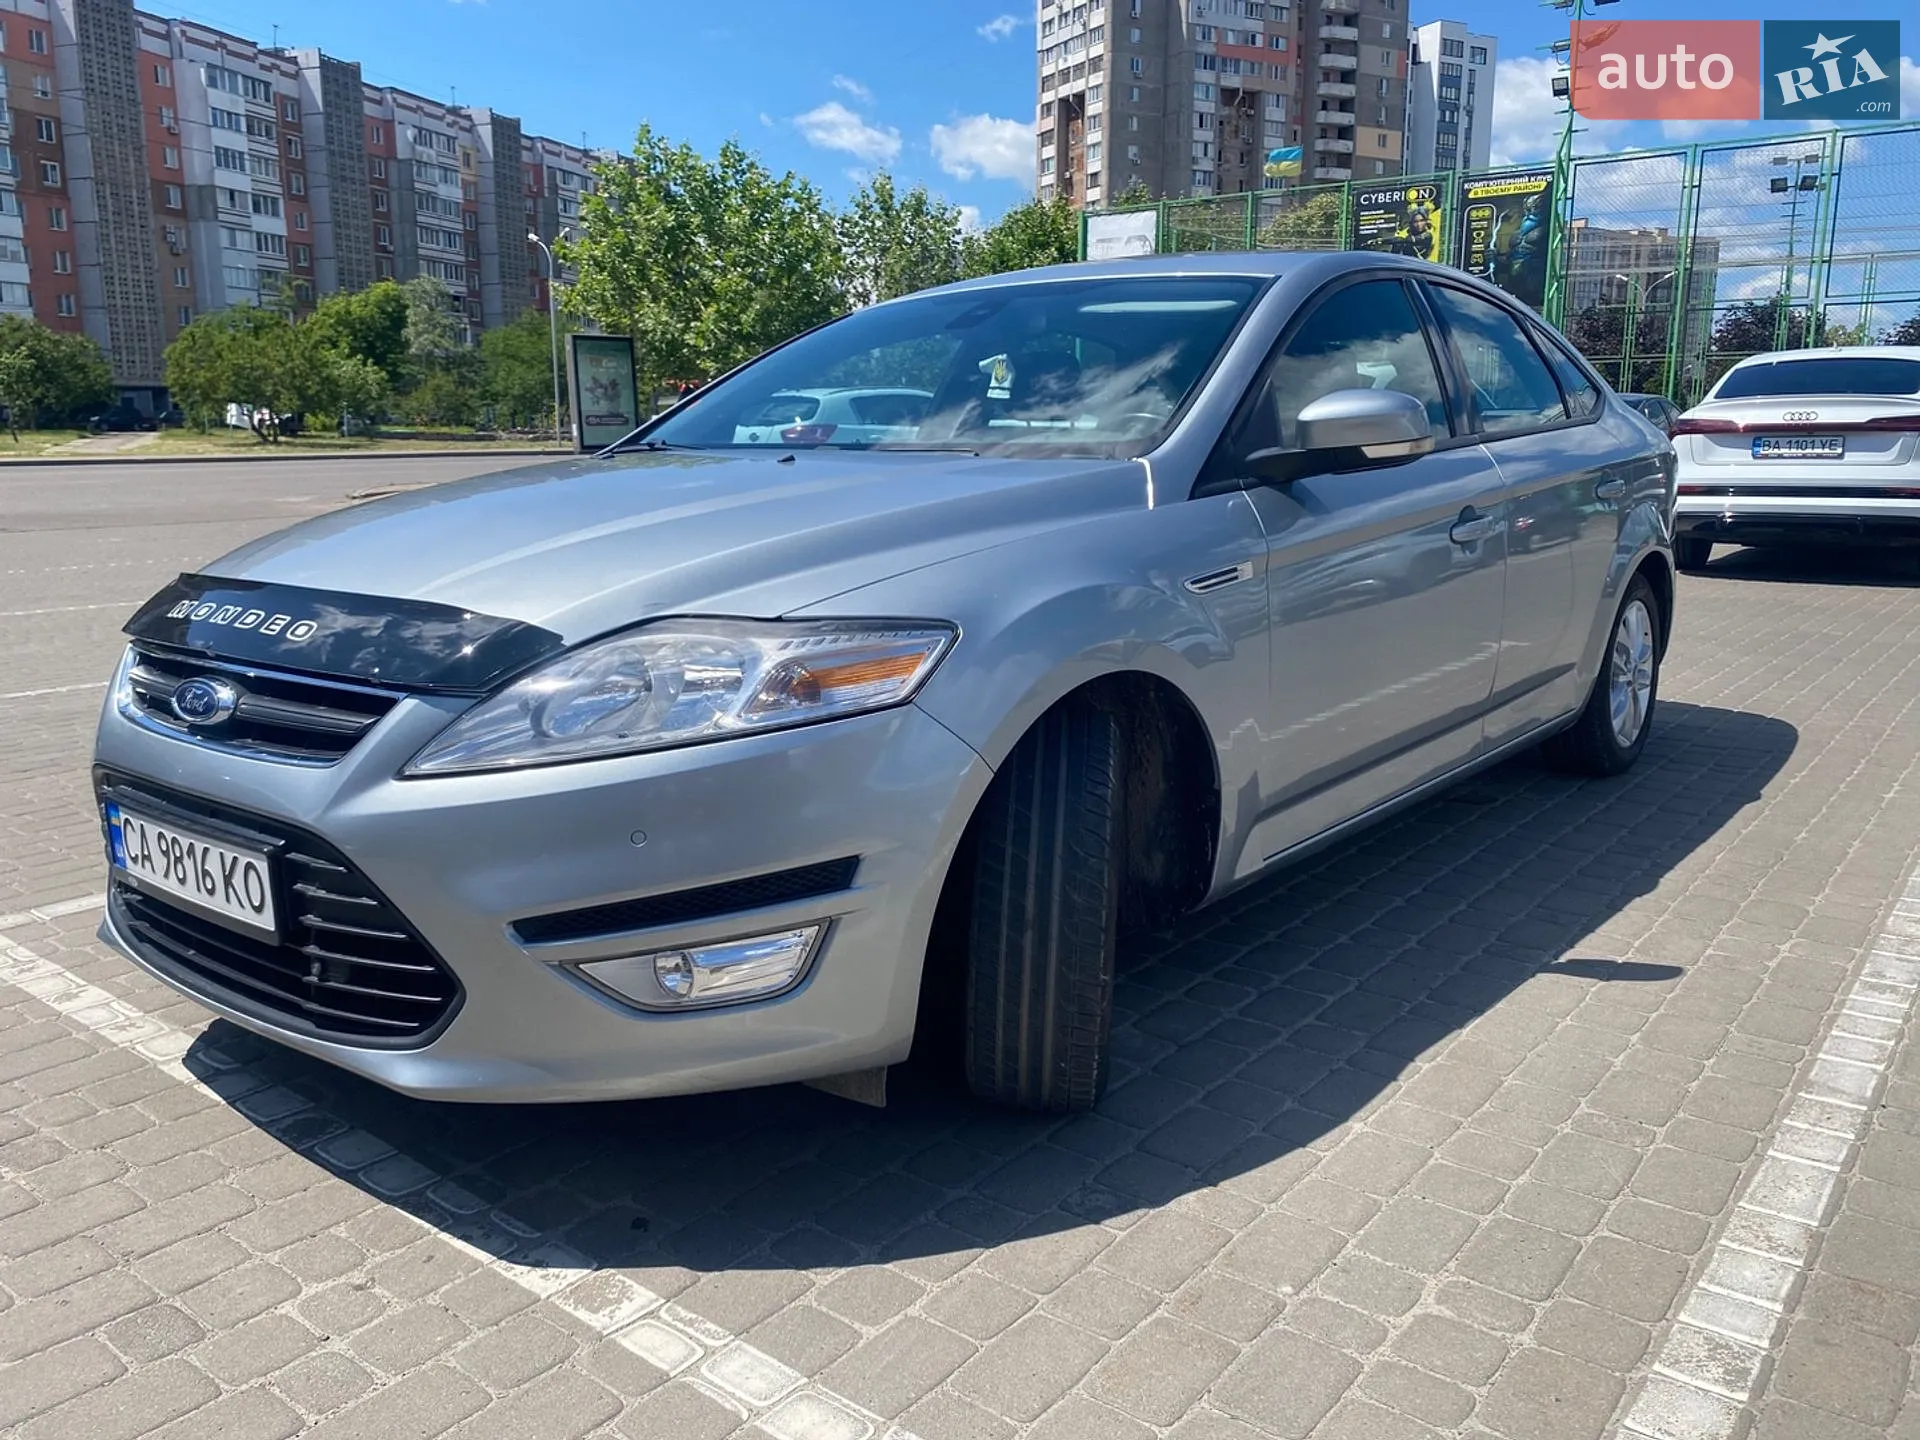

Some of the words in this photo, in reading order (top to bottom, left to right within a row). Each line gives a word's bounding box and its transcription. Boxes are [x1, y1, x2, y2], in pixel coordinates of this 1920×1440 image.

[1360, 187, 1431, 205] CYBERION
[1762, 440, 1781, 452] BA
[1786, 439, 1816, 451] 1101
[1820, 439, 1839, 451] YE
[167, 600, 318, 641] MONDEO
[181, 687, 209, 712] Ford
[123, 817, 156, 876] CA
[157, 831, 216, 897] 9816
[219, 850, 265, 914] KO
